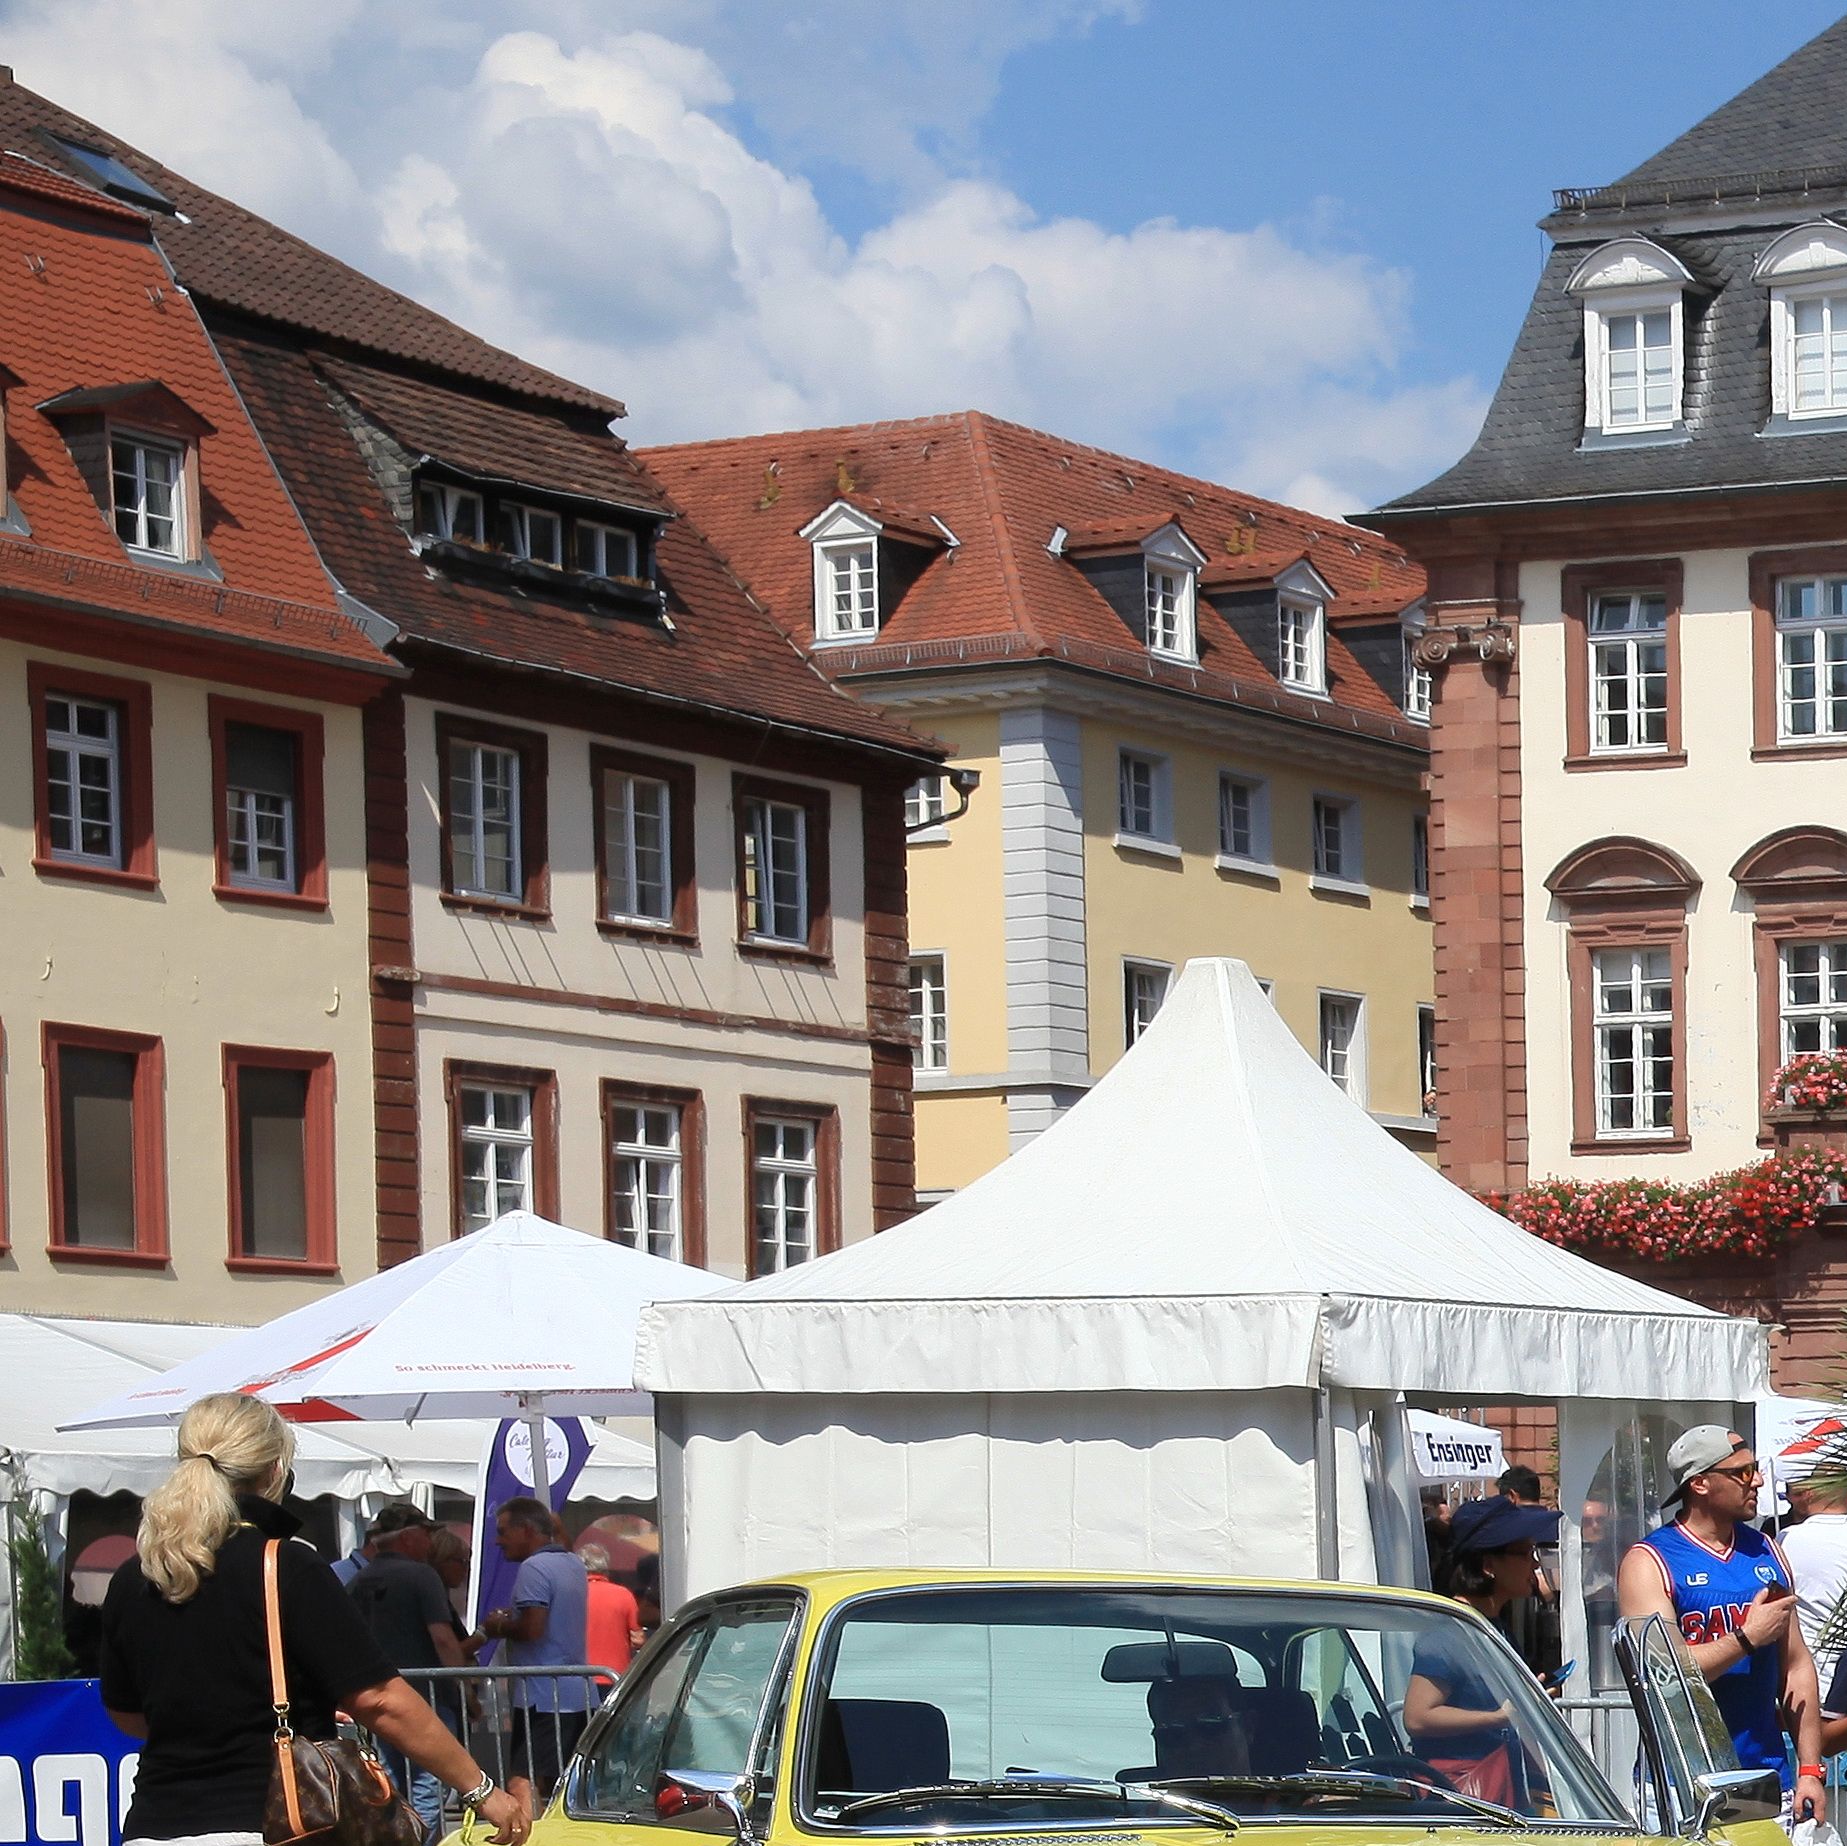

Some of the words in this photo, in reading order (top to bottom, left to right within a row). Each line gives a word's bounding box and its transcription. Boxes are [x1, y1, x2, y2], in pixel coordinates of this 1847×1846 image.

[395, 1364, 413, 1372] So
[417, 1363, 489, 1372] schmeckt
[1426, 1432, 1492, 1471] Ensinger
